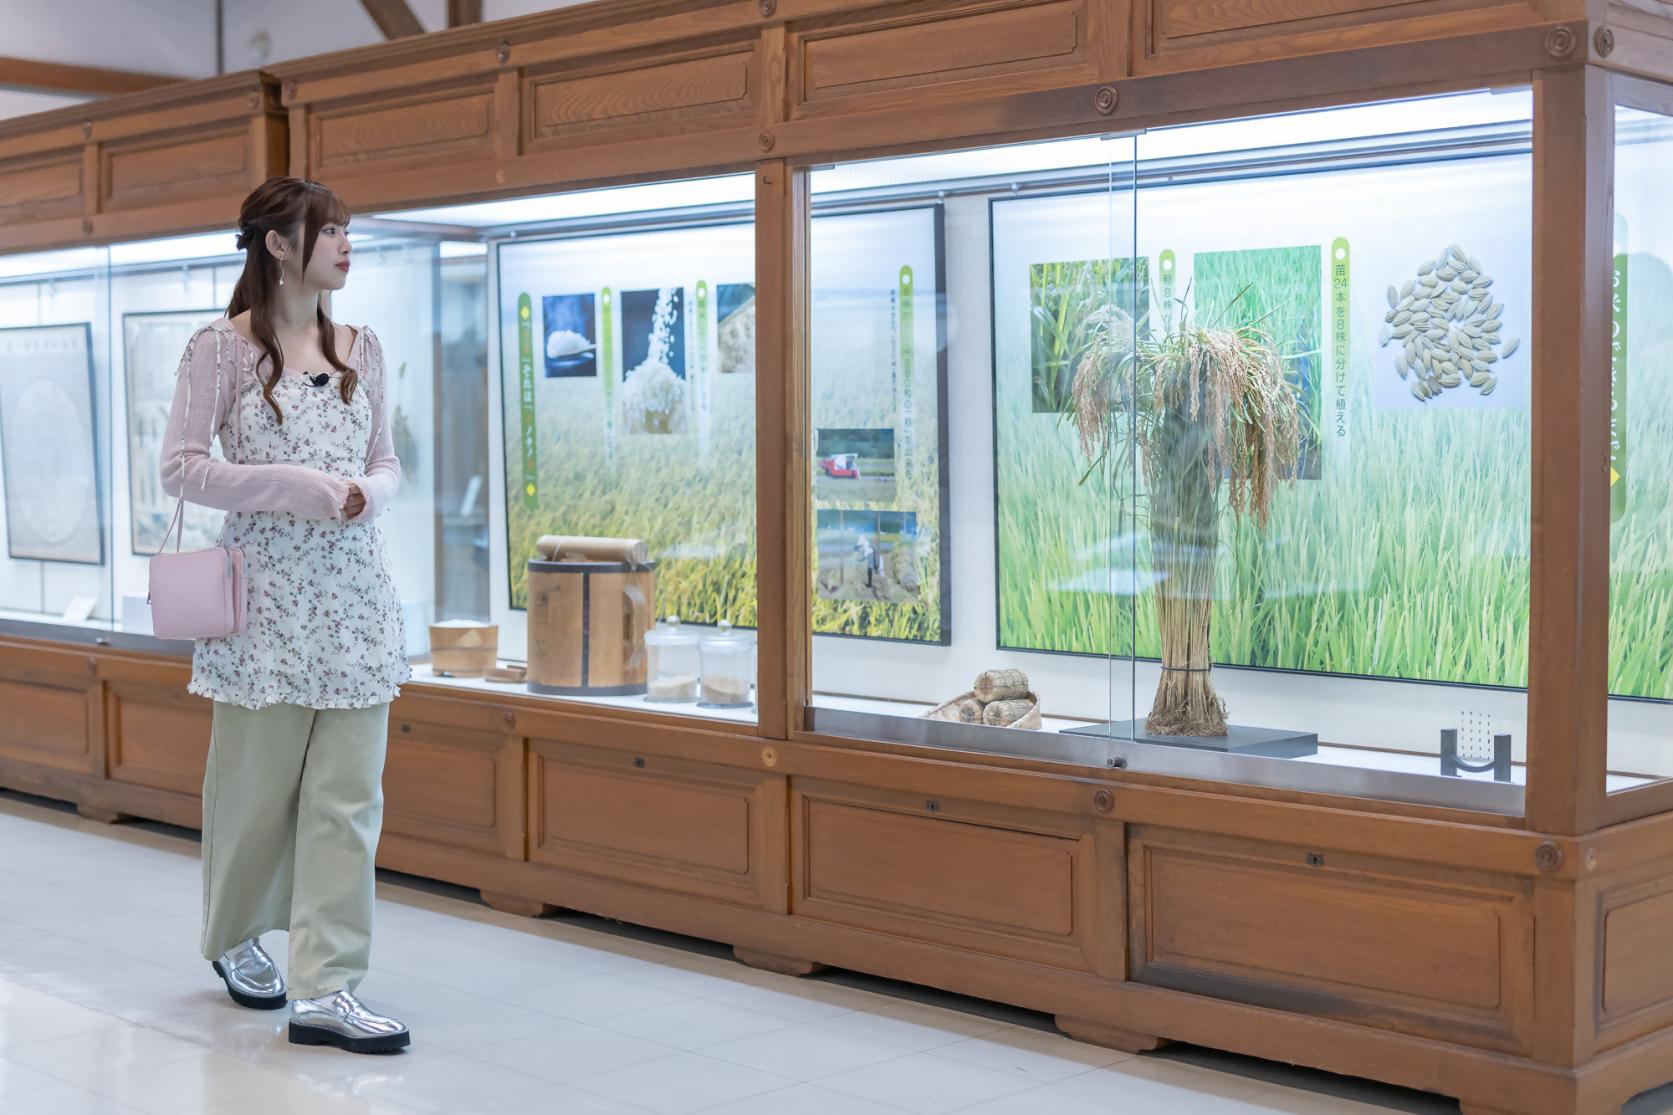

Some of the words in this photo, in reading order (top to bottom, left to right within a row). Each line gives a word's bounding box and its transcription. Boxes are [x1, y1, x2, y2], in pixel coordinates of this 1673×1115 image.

[1333, 264, 1348, 437] 苗24本を8株に分けて植える
